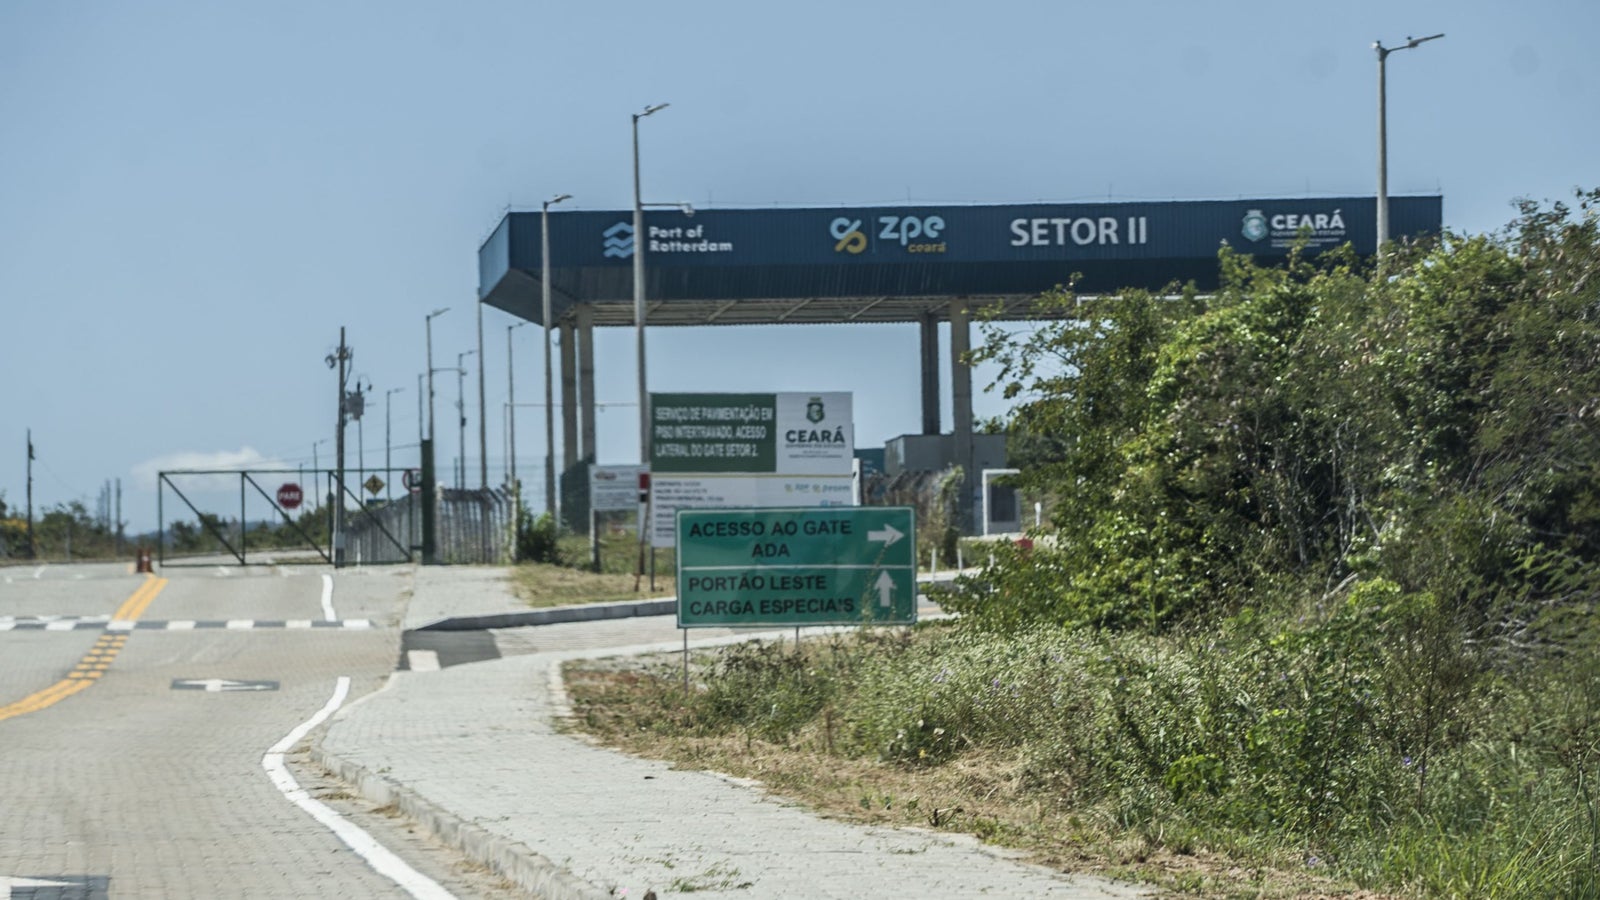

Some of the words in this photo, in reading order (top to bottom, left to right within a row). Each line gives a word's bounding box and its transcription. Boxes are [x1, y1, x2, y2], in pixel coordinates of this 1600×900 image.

[1270, 209, 1345, 230] CEARÁ
[648, 226, 683, 240] Port
[686, 224, 705, 239] of
[878, 215, 946, 246] zpe
[1010, 217, 1119, 247] SETOR
[1128, 216, 1147, 245] II
[648, 238, 733, 253] Rotterdam
[655, 406, 687, 423] SERVIÇO
[690, 406, 701, 421] DE
[702, 404, 760, 423] PAVIMENTAÇÃO
[655, 425, 673, 440] PISO
[736, 425, 767, 439] ACESSO
[785, 425, 846, 444] CEARÁ
[655, 443, 690, 458] LATERAL
[691, 443, 703, 458] DO
[704, 443, 725, 457] GATE
[726, 443, 751, 457] SETOR
[279, 491, 300, 501] PARE
[689, 521, 765, 538] ACESSO
[771, 521, 798, 536] AO
[803, 519, 852, 536] GATE
[752, 543, 791, 558] ADA
[689, 573, 766, 592] PORTÃO
[770, 575, 827, 591] LESTE
[690, 600, 754, 616] CARGA
